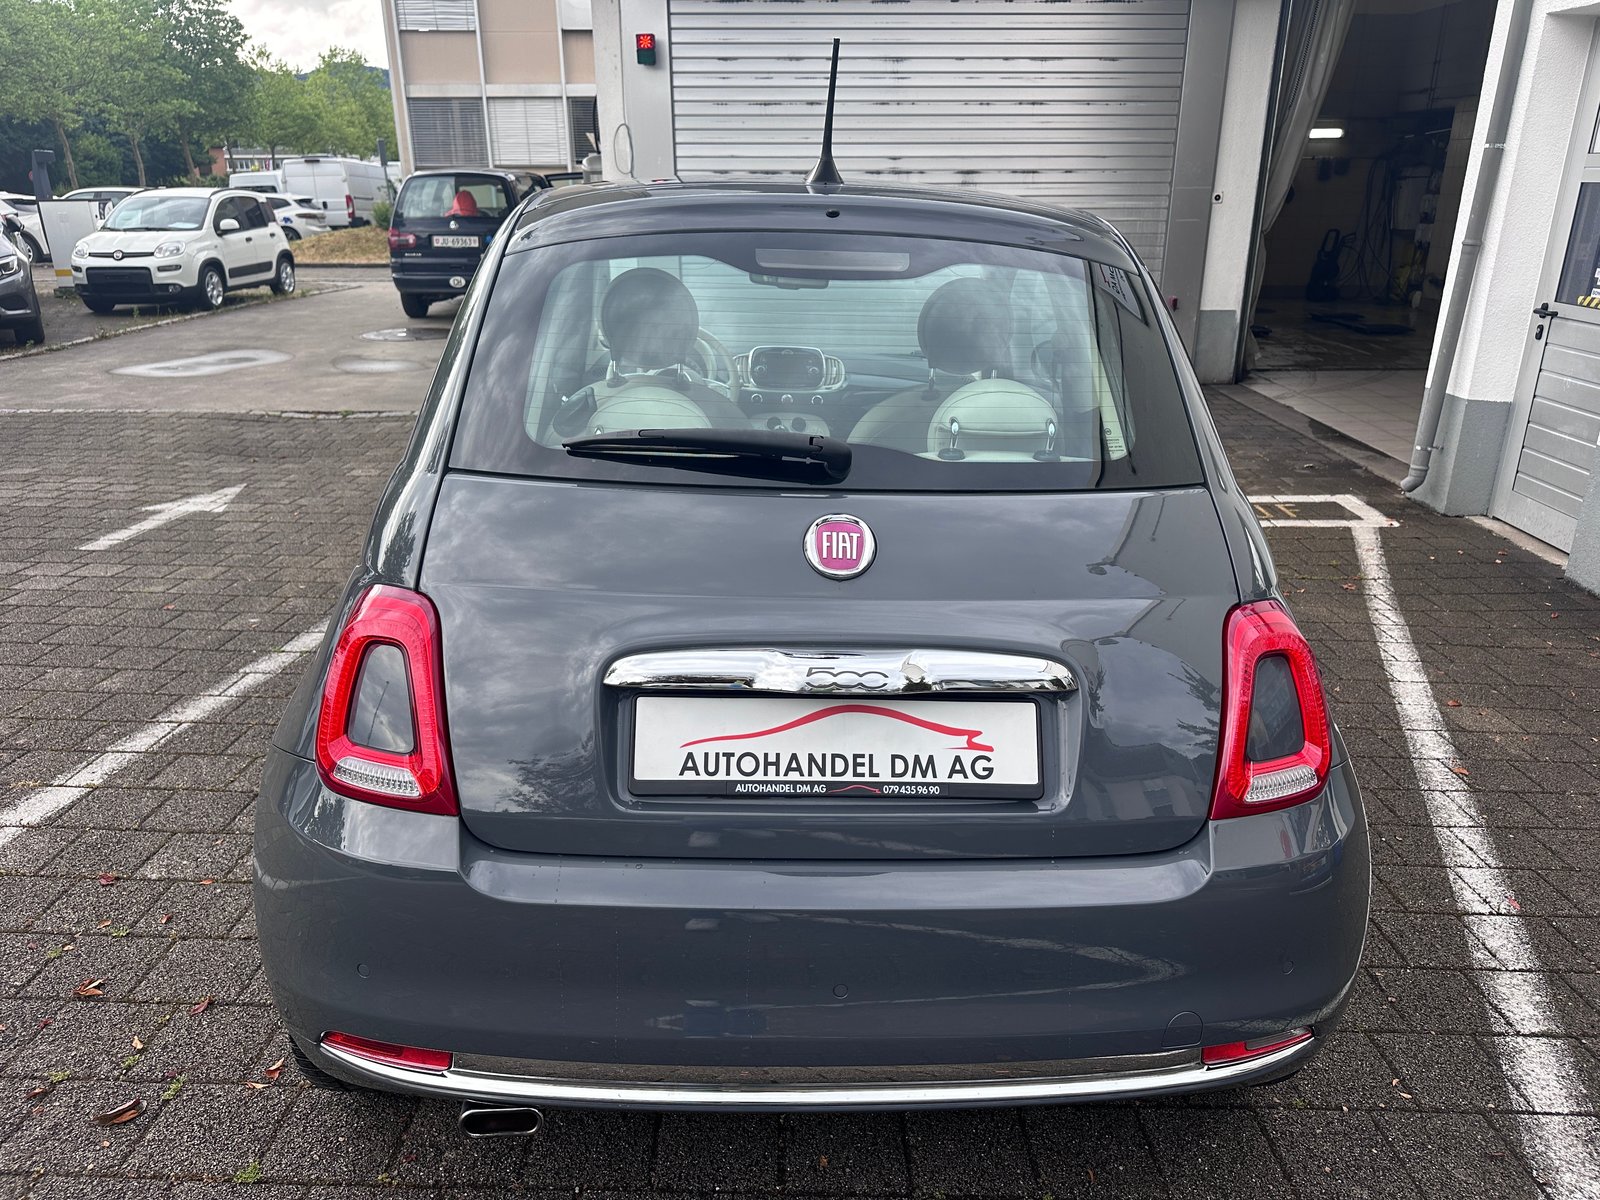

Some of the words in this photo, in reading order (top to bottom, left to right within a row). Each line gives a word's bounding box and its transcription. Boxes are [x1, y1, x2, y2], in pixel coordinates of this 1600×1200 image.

[822, 531, 860, 560] FIAT
[805, 667, 889, 689] 500
[679, 751, 880, 778] AUTOHANDEL
[891, 754, 937, 778] DM
[947, 754, 994, 780] AG
[735, 783, 795, 793] AUTOHANDEL
[796, 784, 811, 793] DM
[812, 784, 827, 793] AG
[883, 785, 899, 794] 079
[900, 785, 916, 794] 435
[917, 785, 929, 794] 96
[929, 785, 940, 795] 90
